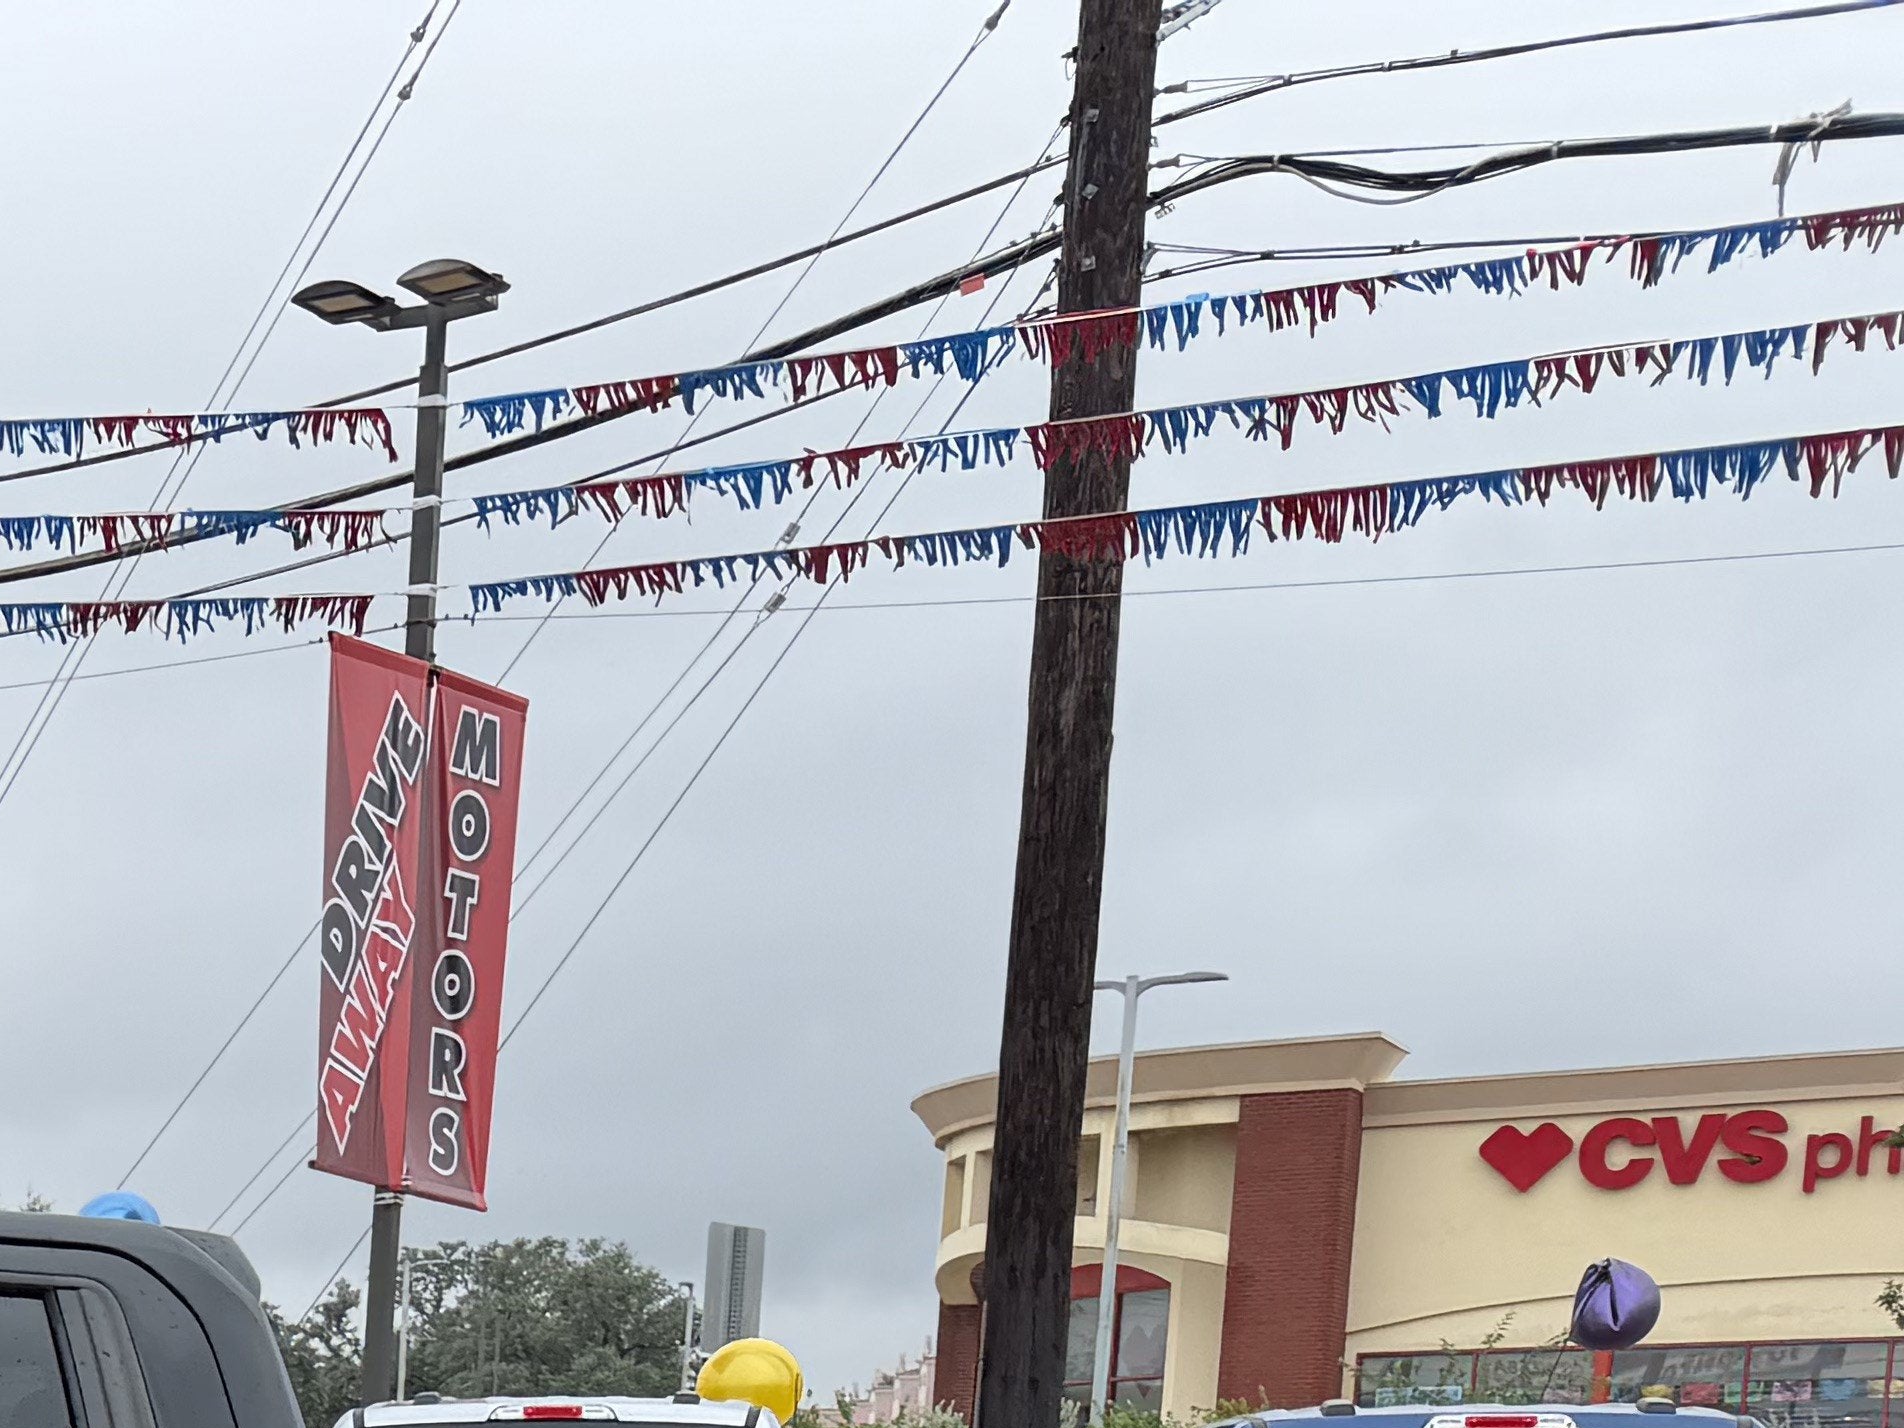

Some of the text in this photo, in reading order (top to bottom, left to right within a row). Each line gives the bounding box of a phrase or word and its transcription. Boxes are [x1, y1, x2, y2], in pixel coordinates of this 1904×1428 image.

[322, 691, 426, 992] DRIVE
[428, 704, 501, 1177] MOTORS
[319, 862, 416, 1157] AWAY
[1578, 1109, 1789, 1191] CVS
